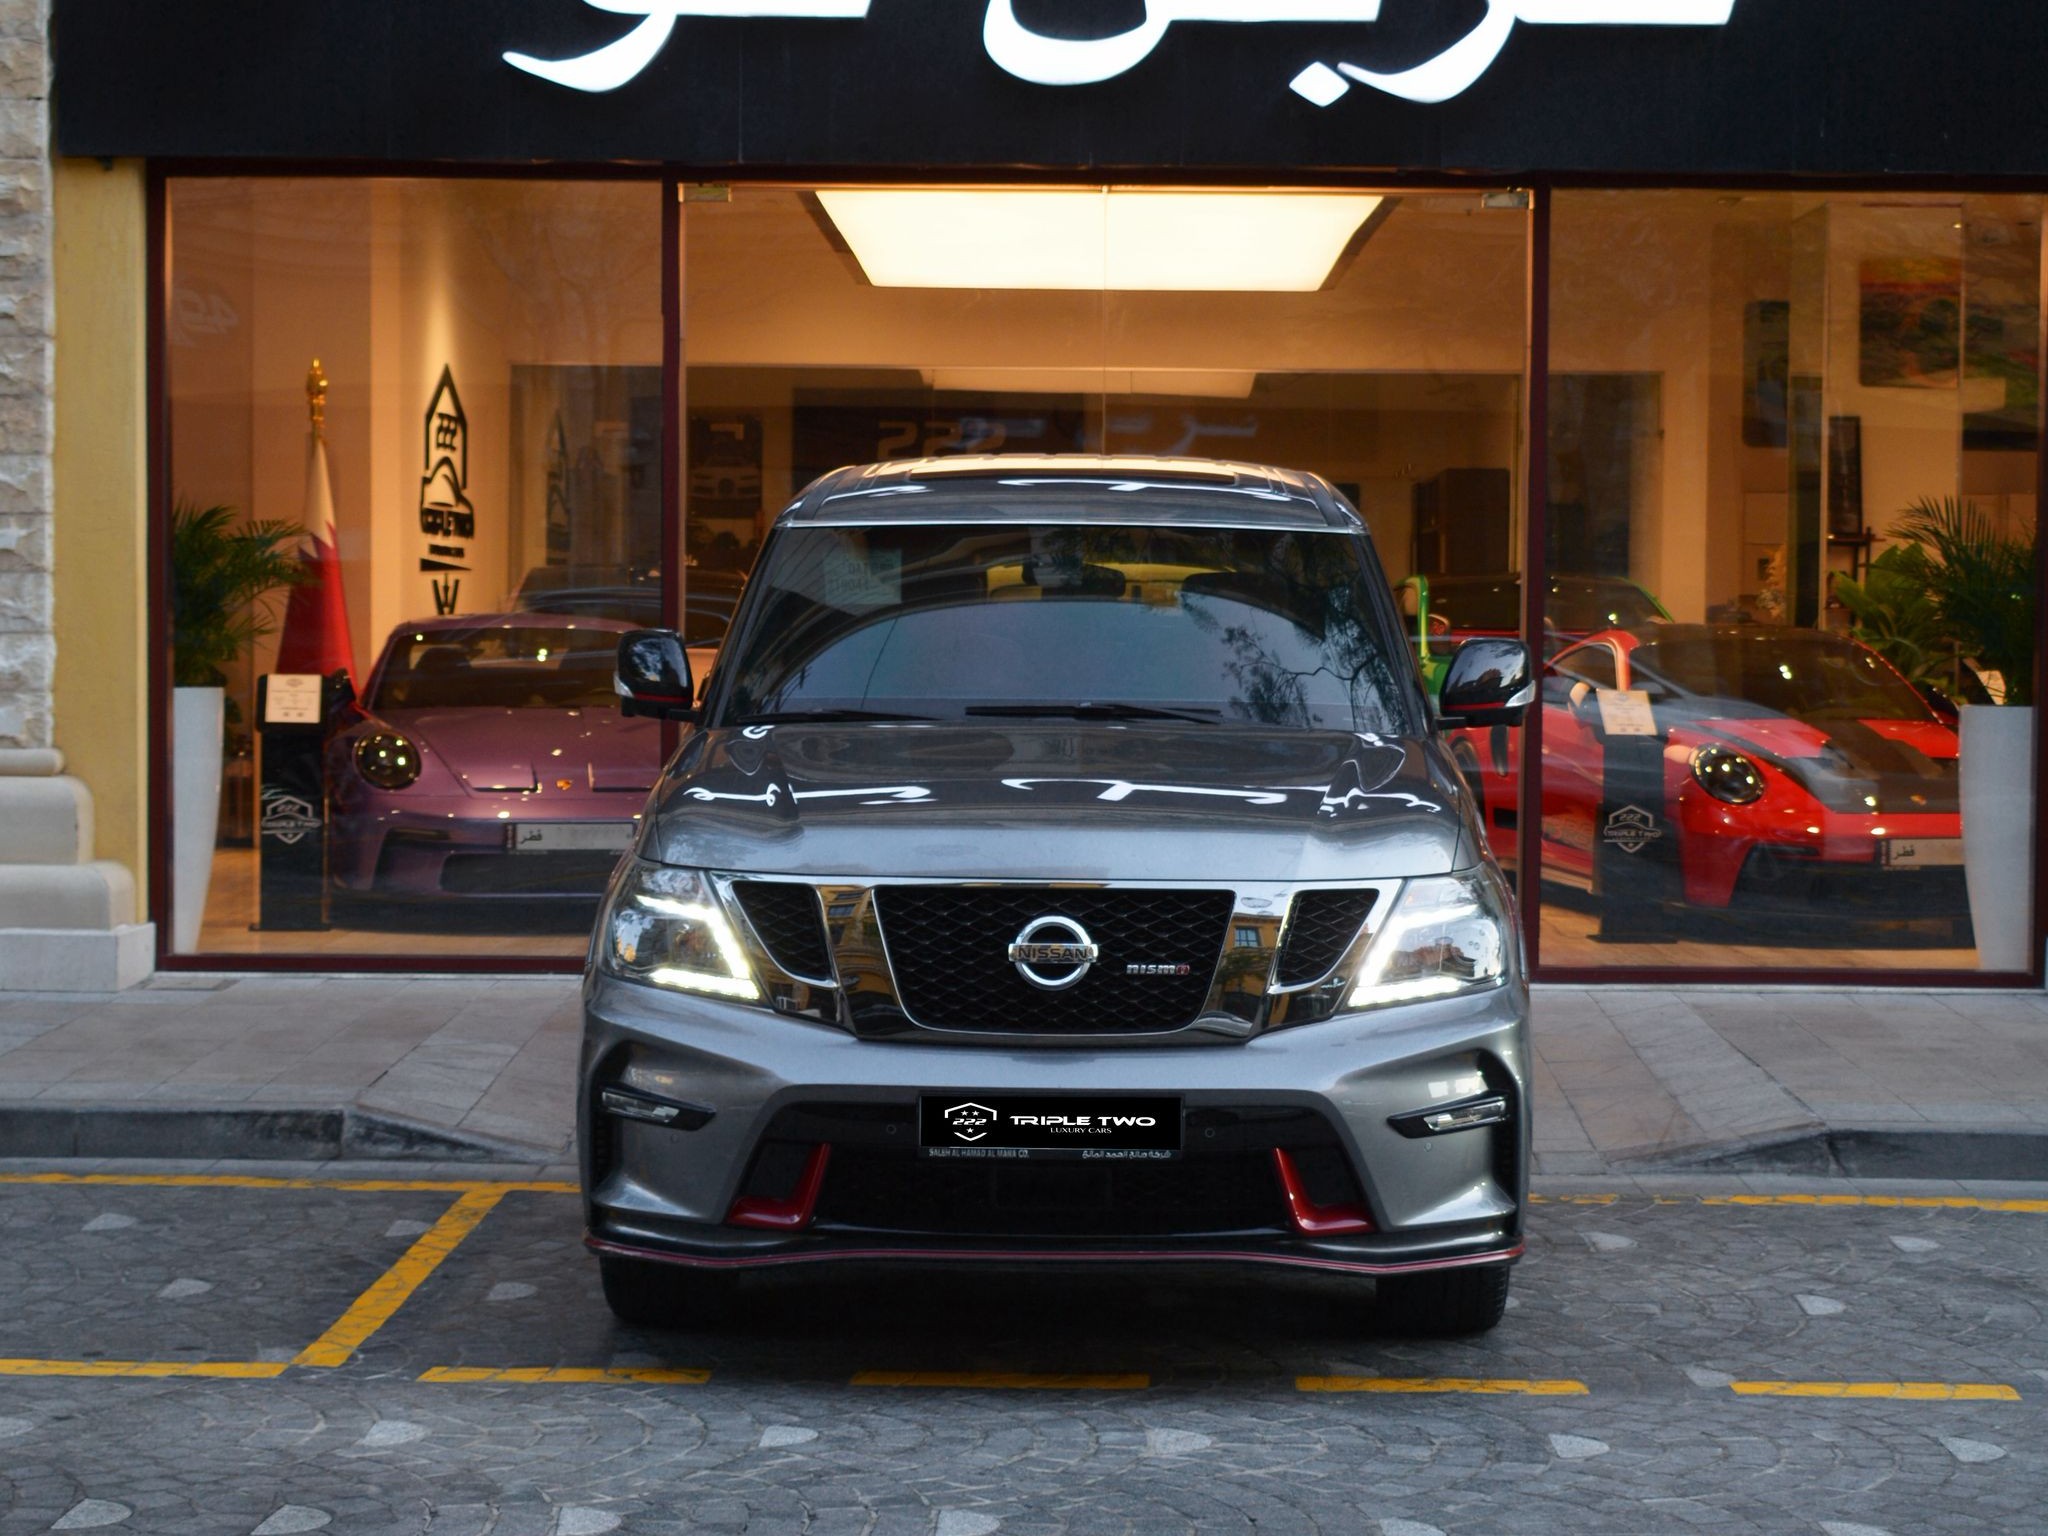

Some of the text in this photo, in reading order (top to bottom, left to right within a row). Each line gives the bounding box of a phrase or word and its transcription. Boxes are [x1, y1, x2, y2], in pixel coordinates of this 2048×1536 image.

[520, 829, 543, 844] قطر
[1017, 947, 1088, 960] NISSAN
[952, 1117, 988, 1126] 222
[1009, 1115, 1157, 1127] TRIPLE TWO
